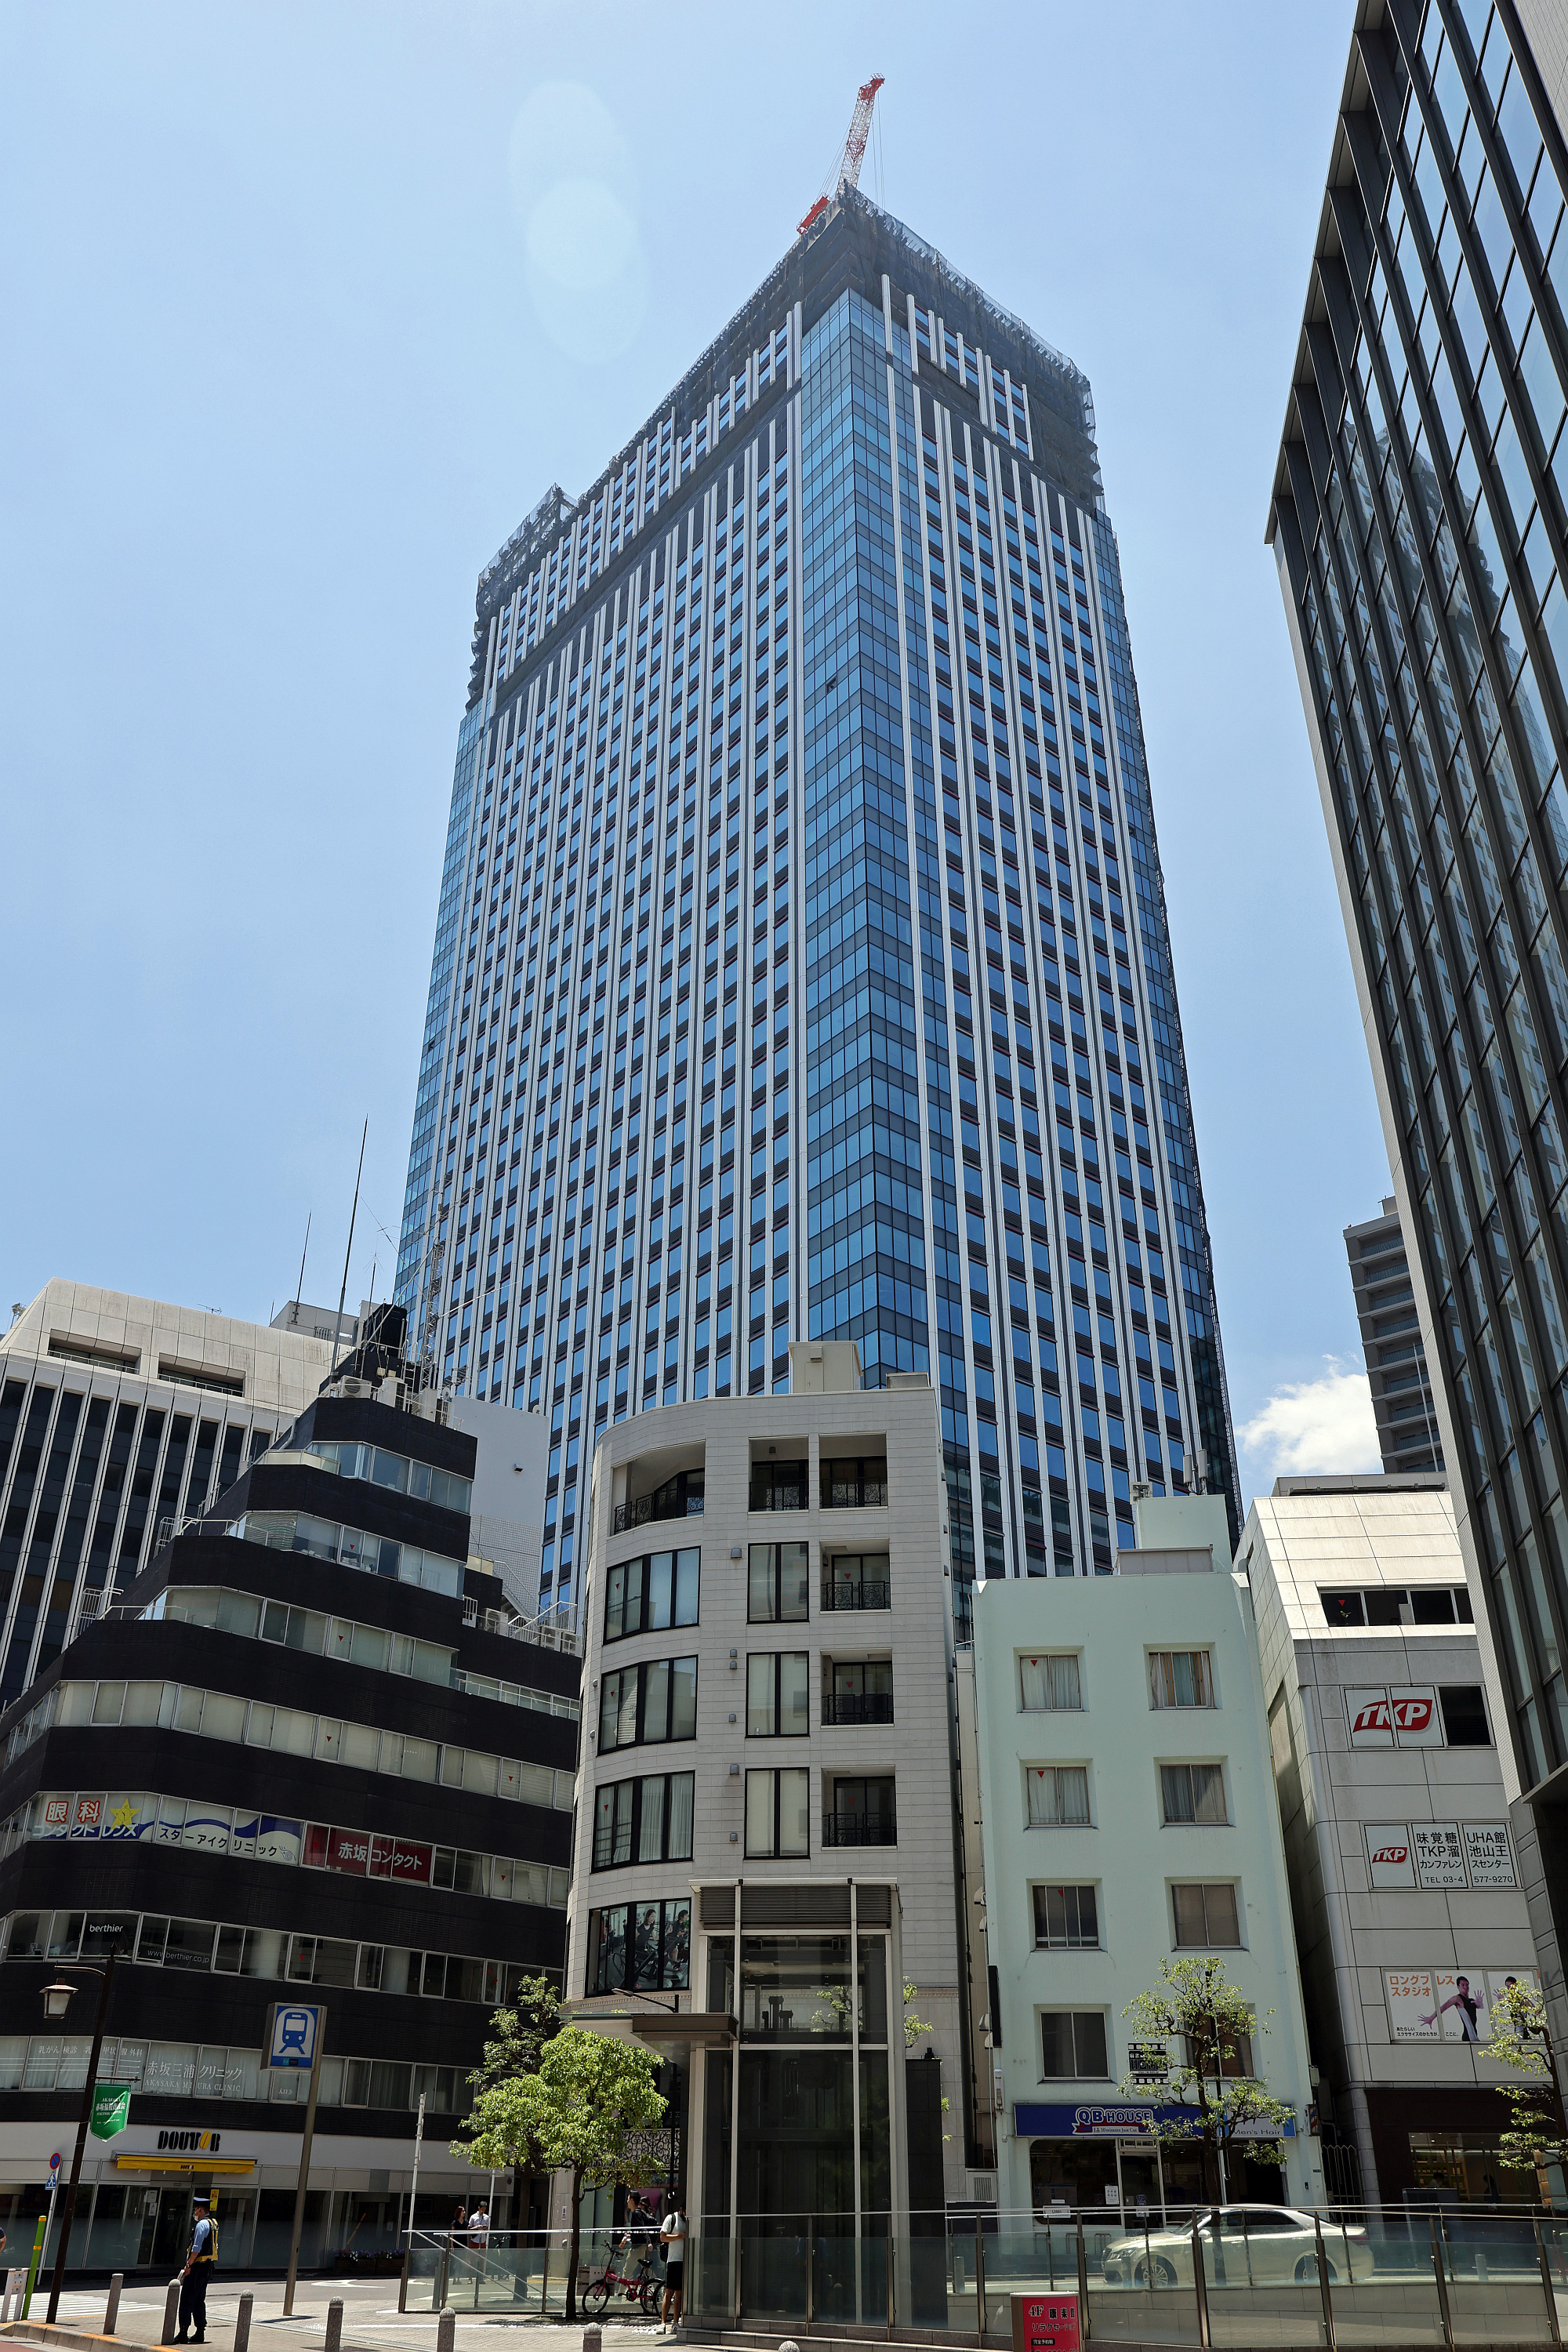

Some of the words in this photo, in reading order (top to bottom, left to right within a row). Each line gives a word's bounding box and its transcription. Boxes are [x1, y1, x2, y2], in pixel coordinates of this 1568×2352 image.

[1361, 1703, 1428, 1726] TKP
[45, 1801, 100, 1823] 眼科
[33, 1824, 139, 1837] コンタクトレンズ
[159, 1828, 277, 1857] スターアイクリニック
[338, 1842, 423, 1871] 赤坂コンタクト
[1375, 1848, 1406, 1861] TKP
[89, 1924, 123, 1933] berthier
[147, 1949, 209, 1963] wwwberthier.co.jp
[1389, 1976, 1455, 1986] ロングブレス
[1391, 1987, 1431, 1997] スタジオ
[145, 2079, 179, 2088] AKASAKA
[214, 2083, 241, 2092] CLINIC
[1077, 2109, 1104, 2124] QB
[1106, 2110, 1152, 2123] HOUSE
[158, 2131, 220, 2151] DOUTOR
[1029, 2305, 1044, 2317] 4F
[1032, 2322, 1076, 2332] リラクゼーション
